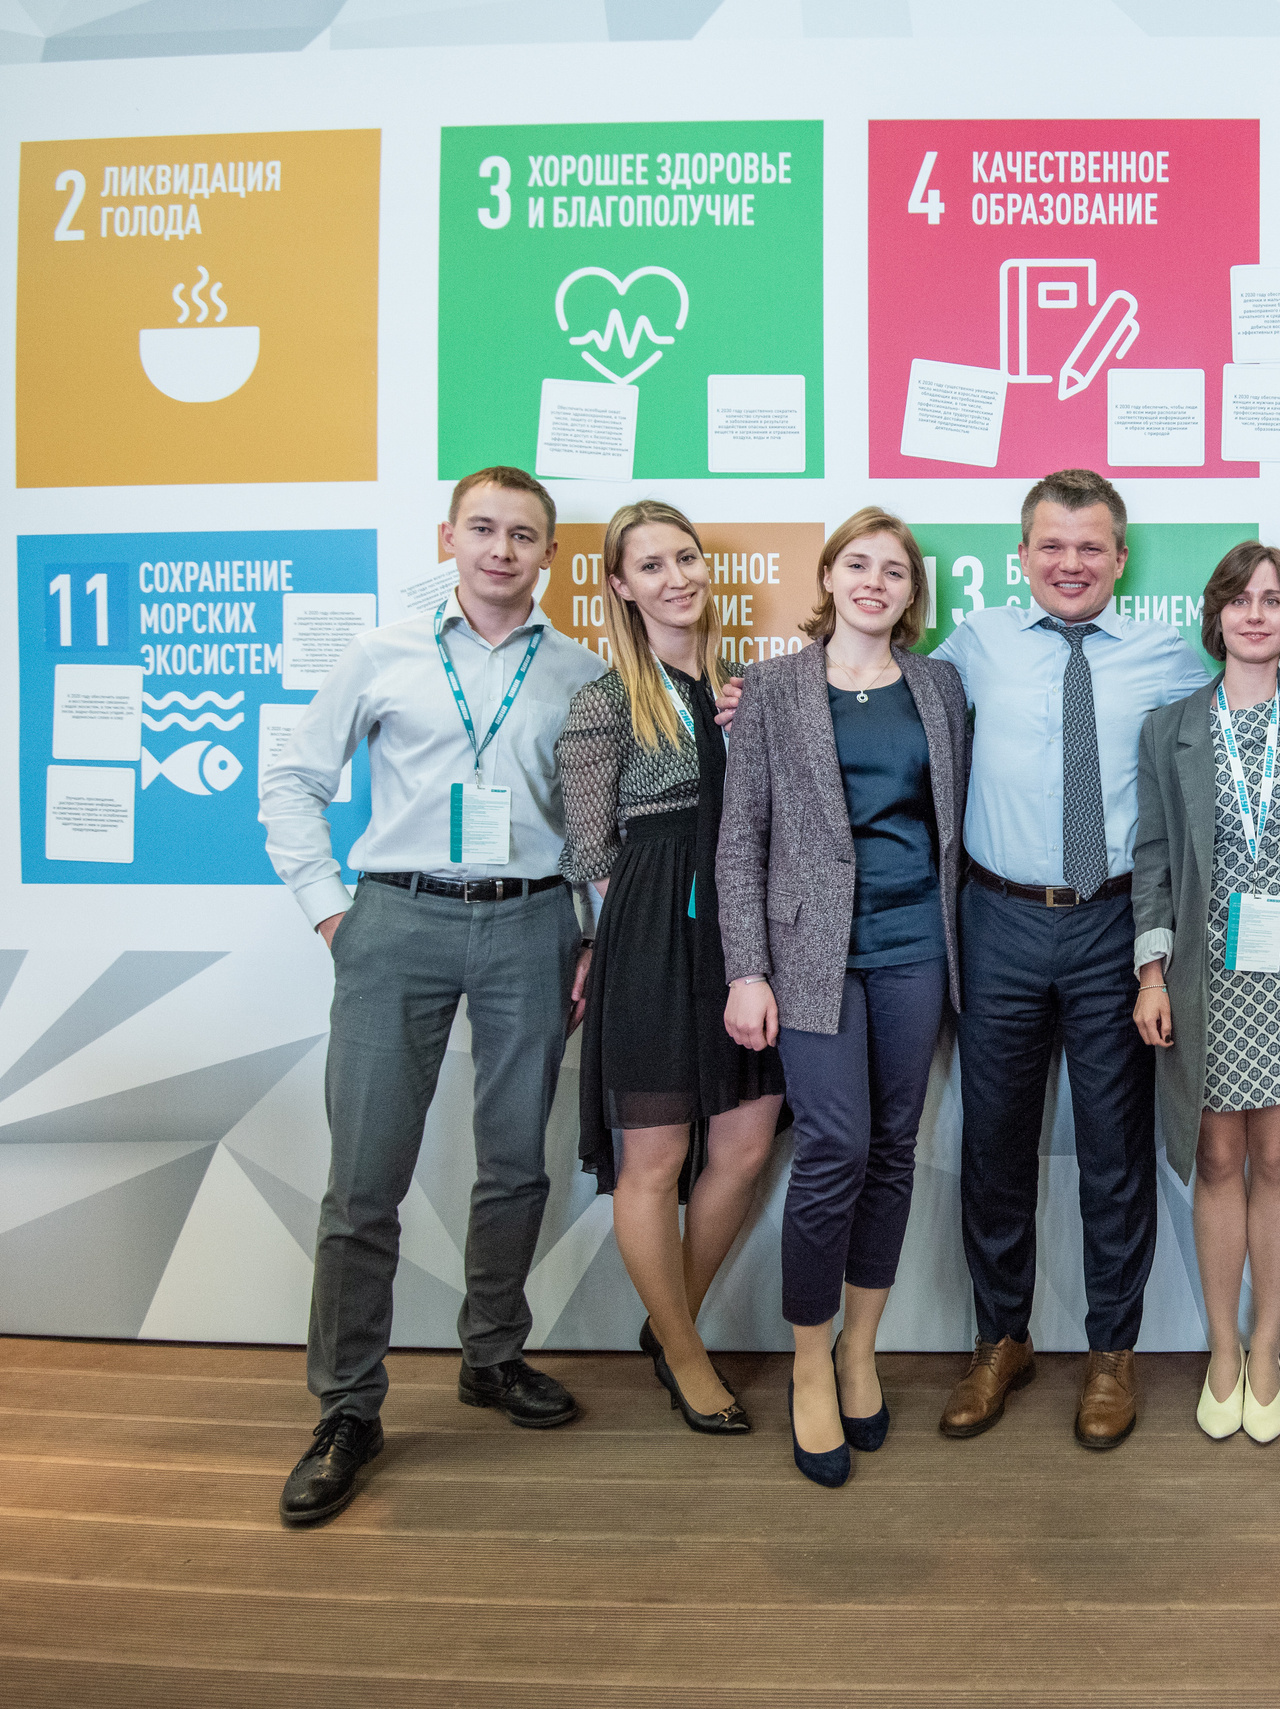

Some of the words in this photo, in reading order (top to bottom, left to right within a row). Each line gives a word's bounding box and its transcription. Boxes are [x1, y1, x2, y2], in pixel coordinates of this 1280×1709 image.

[99, 159, 282, 200] ЛИКВИДАЦИЯ
[527, 153, 649, 188] ХОРОШЕЕ
[655, 151, 792, 191] ЗДОРОВЬЕ
[972, 150, 1170, 184] КАЧЕСТВЕННОЕ
[53, 169, 87, 242] 2
[477, 155, 512, 230] 3
[907, 151, 946, 225] 4
[100, 203, 203, 241] ГОЛОДА
[528, 196, 545, 229] И
[552, 193, 755, 228] БЛАГОПОЛУЧИЕ
[971, 192, 1158, 226] ОБРАЗОВАНИЕ
[138, 559, 294, 594] СОХРАНЕНИЕ
[49, 573, 109, 647] 11
[140, 601, 257, 635] МОРСКИХ
[140, 643, 283, 677] ЭКОСИСТЕМ
[678, 709, 695, 735] СИБУ
